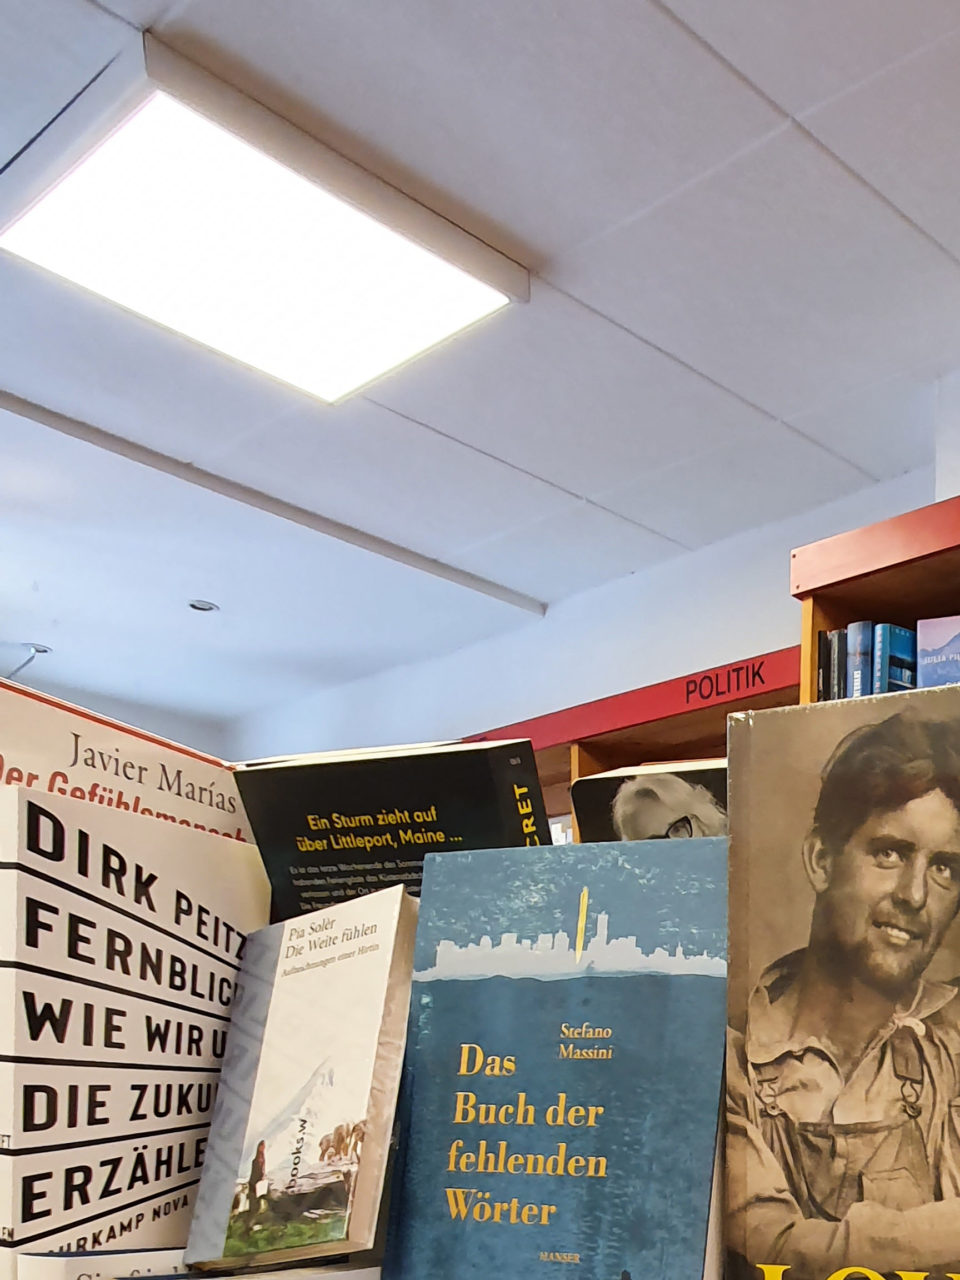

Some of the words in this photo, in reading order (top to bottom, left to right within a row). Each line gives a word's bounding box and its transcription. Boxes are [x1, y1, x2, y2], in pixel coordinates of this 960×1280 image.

[923, 653, 946, 664] JULIA
[684, 660, 766, 704] POLITIK
[69, 731, 148, 785] Javier
[156, 762, 237, 815] Marías
[306, 814, 331, 831] Ein
[332, 811, 374, 829] Sturm
[376, 807, 411, 825] zieht
[413, 805, 438, 823] auf
[295, 835, 328, 852] über
[400, 827, 446, 844] Maine
[26, 799, 159, 914] DIRK
[174, 888, 249, 961] PEITZ
[22, 989, 127, 1051] WIE
[145, 1014, 204, 1057] WIR
[559, 1021, 613, 1040] Stefano
[456, 1042, 517, 1077] Das
[558, 1044, 614, 1060] Massini
[22, 1084, 112, 1133] DIE
[453, 1092, 536, 1127] Buch
[545, 1092, 606, 1128] der
[445, 1139, 608, 1178] fehlenden
[444, 1187, 559, 1227] Wörter
